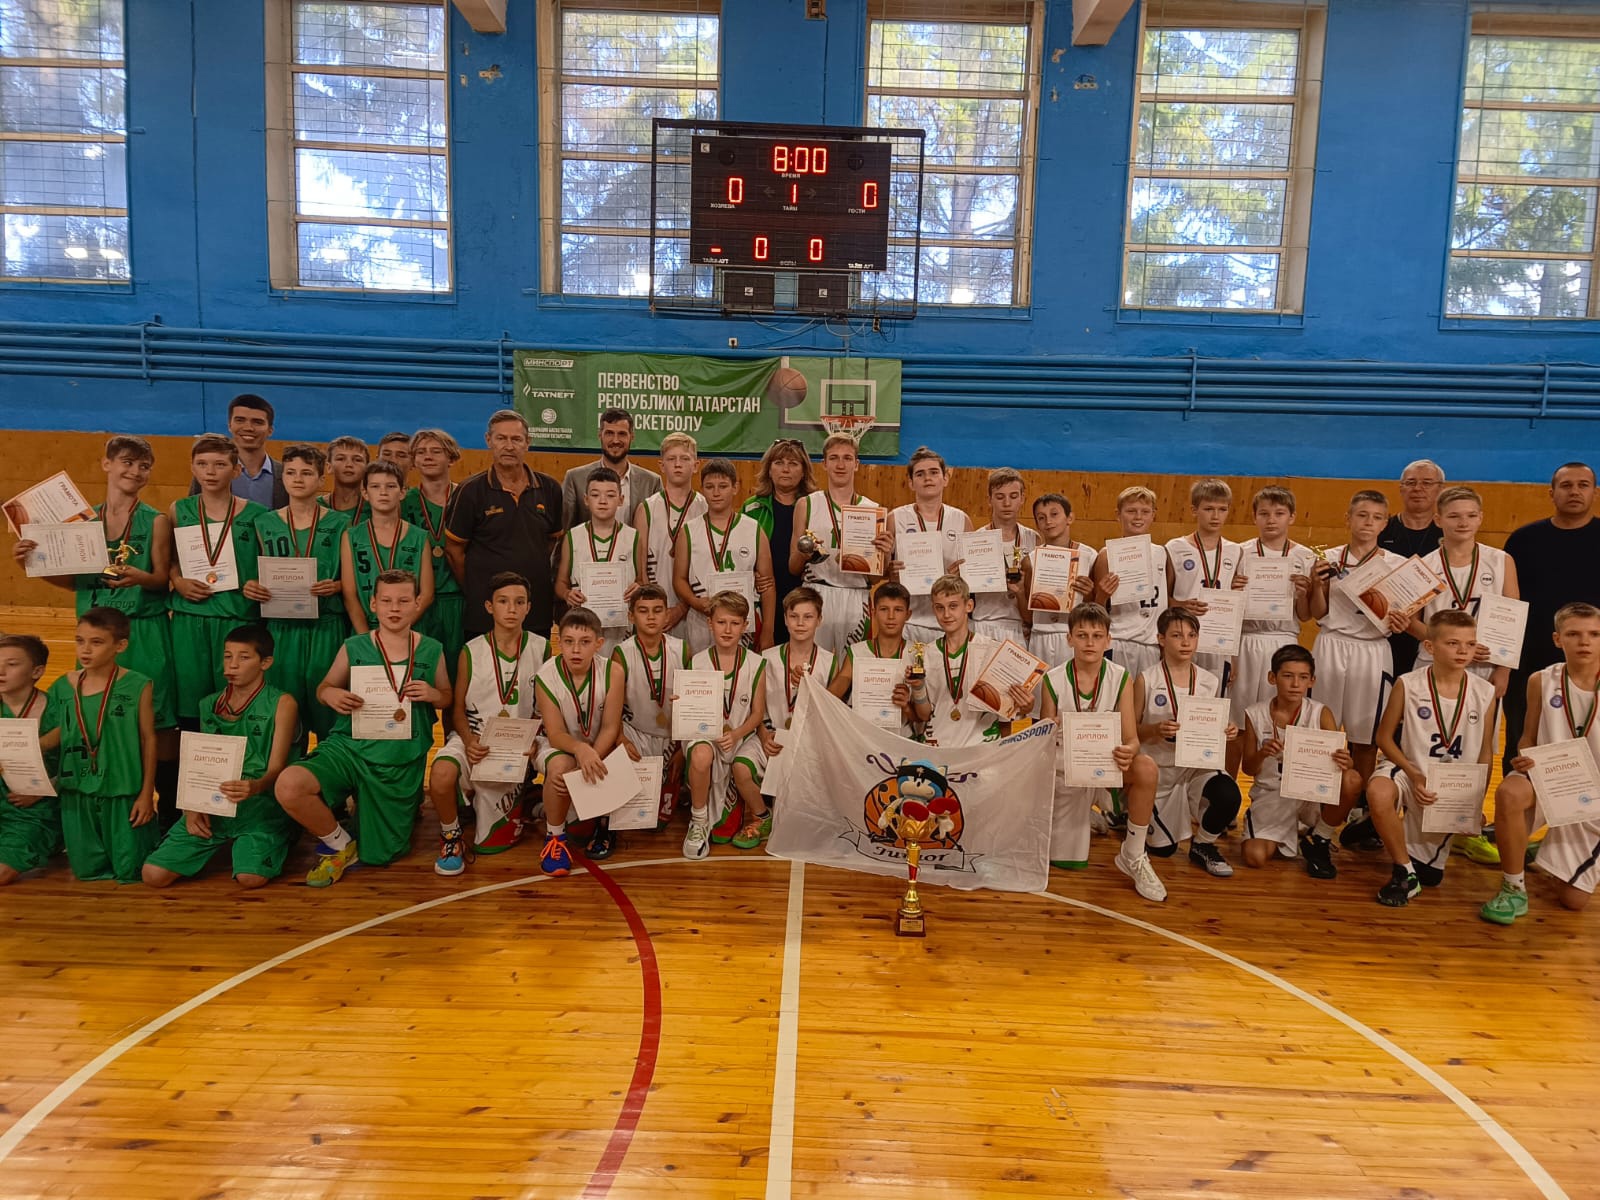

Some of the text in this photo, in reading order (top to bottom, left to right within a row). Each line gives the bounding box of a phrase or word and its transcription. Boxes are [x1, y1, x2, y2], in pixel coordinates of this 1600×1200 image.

[774, 146, 827, 173] 8:00
[728, 177, 742, 203] 0
[792, 184, 797, 204] 1
[863, 182, 878, 208] 0
[755, 237, 767, 259] 0
[809, 239, 822, 261] 0
[524, 358, 574, 368] МИНСПОРТ
[597, 372, 680, 391] ПЕРВЕНСТВО
[531, 391, 576, 399] TATNEFT
[597, 392, 761, 413] РЕСПУБЛИКИ ТАТАРСТАН
[630, 413, 703, 432] СКЕТБОЛУ
[264, 536, 290, 557] 10
[356, 550, 371, 573] 5
[1076, 732, 1109, 741] ДИПЛОМ
[1429, 733, 1463, 760] 24
[193, 753, 229, 765] ДИПЛОМ
[1545, 761, 1581, 776] ДИПЛОМ
